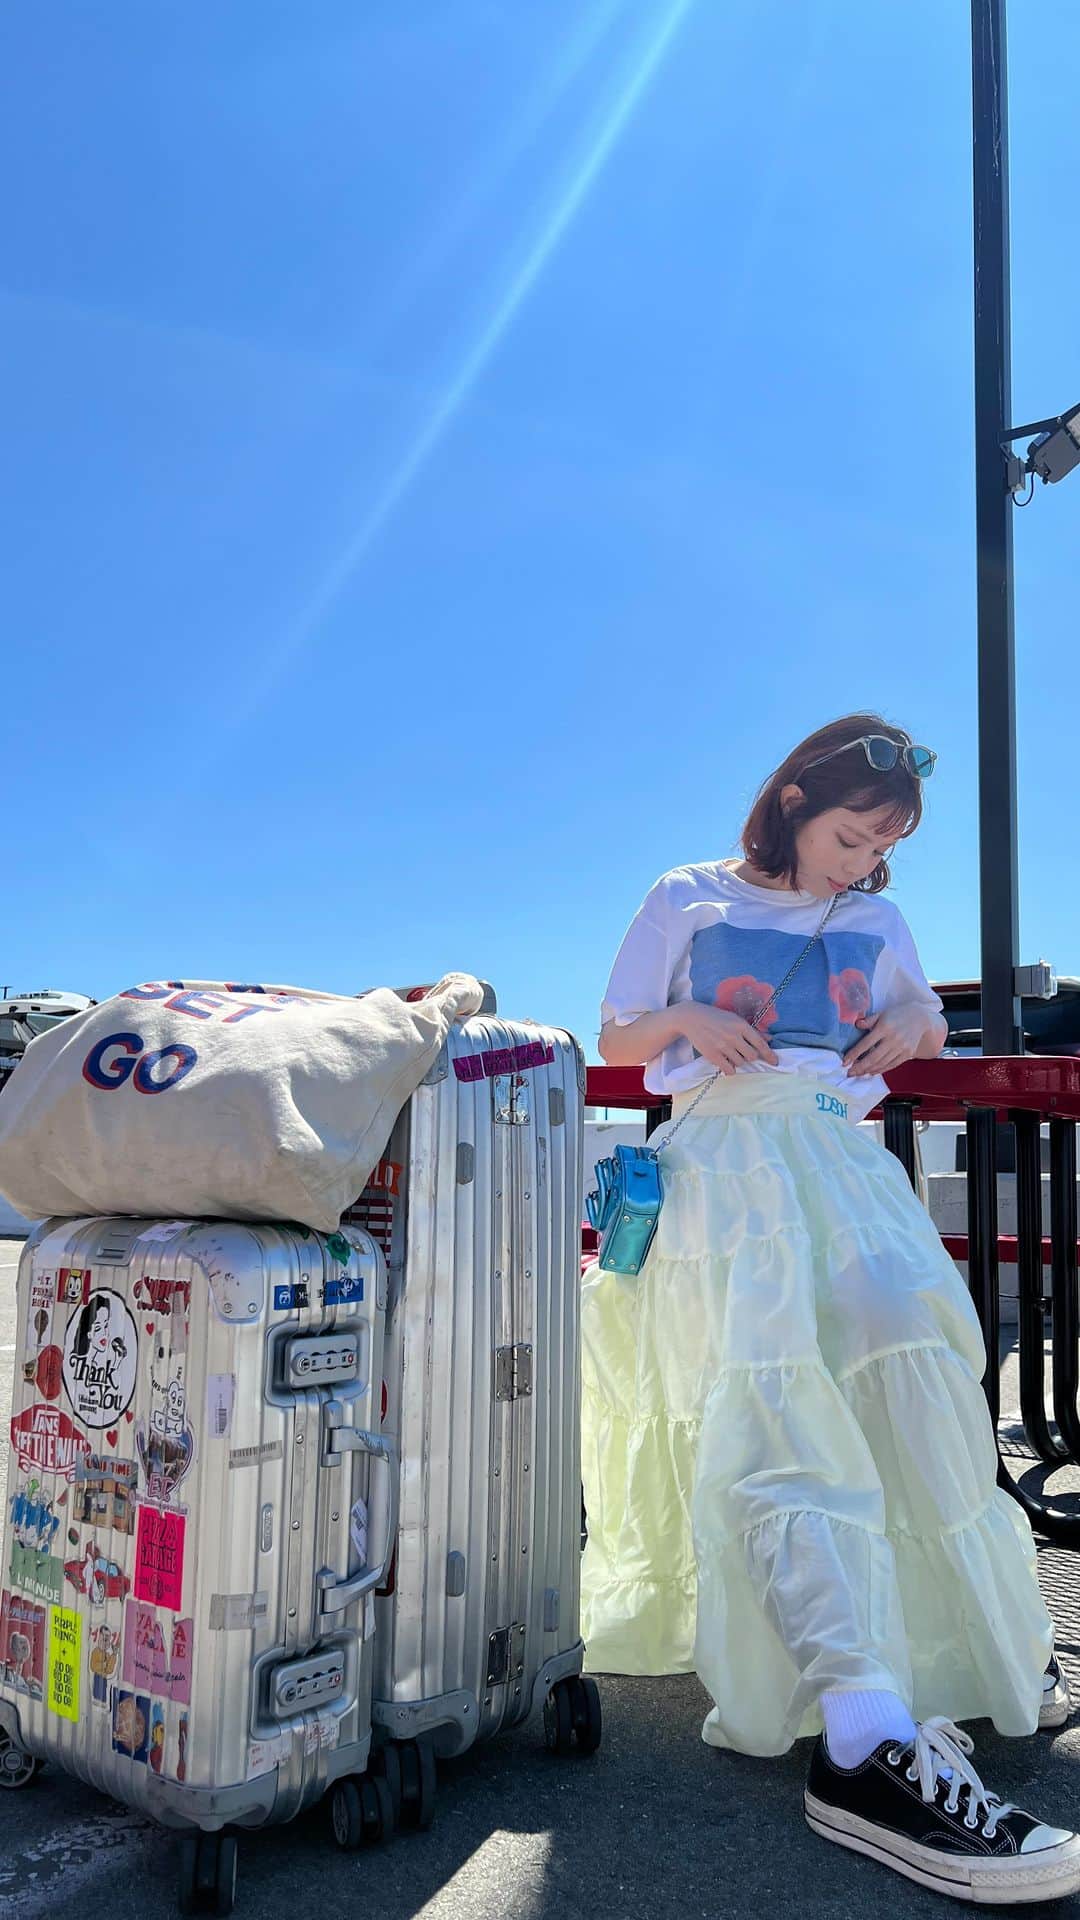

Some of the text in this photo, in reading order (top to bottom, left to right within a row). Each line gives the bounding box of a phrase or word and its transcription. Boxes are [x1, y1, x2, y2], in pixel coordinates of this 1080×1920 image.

[82, 1032, 198, 1095] GO
[69, 1355, 120, 1390] Thank
[89, 1383, 123, 1411] You
